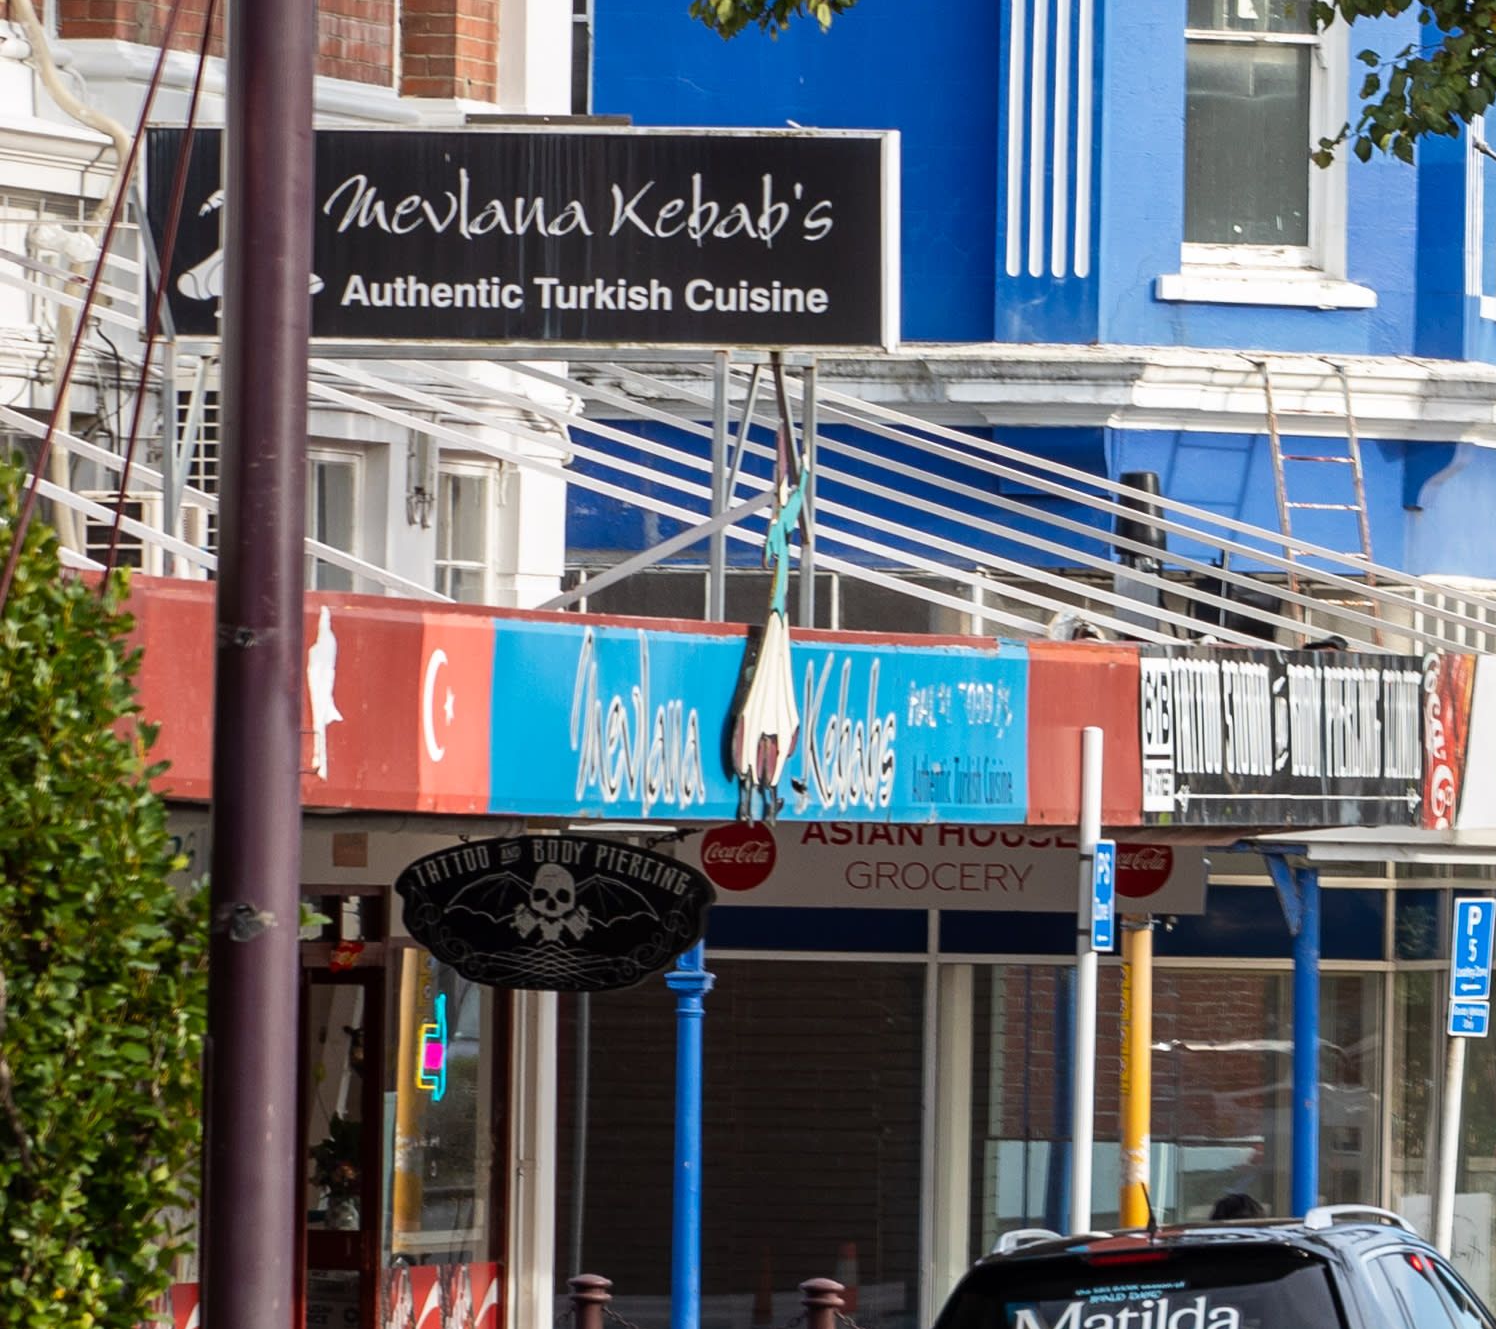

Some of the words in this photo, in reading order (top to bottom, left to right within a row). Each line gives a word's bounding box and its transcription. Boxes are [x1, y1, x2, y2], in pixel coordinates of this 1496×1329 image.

[323, 168, 593, 240] Mevlana
[609, 172, 833, 248] Kebab's
[341, 275, 523, 310] Authentic
[533, 277, 673, 311] Turkish
[685, 279, 829, 313] Cuisine
[412, 845, 490, 887] TATTOO
[533, 839, 586, 863] BODY
[595, 844, 692, 896] PIERCING
[845, 860, 1033, 892] GROCERY
[1466, 905, 1483, 936] P
[1468, 938, 1478, 962] 5
